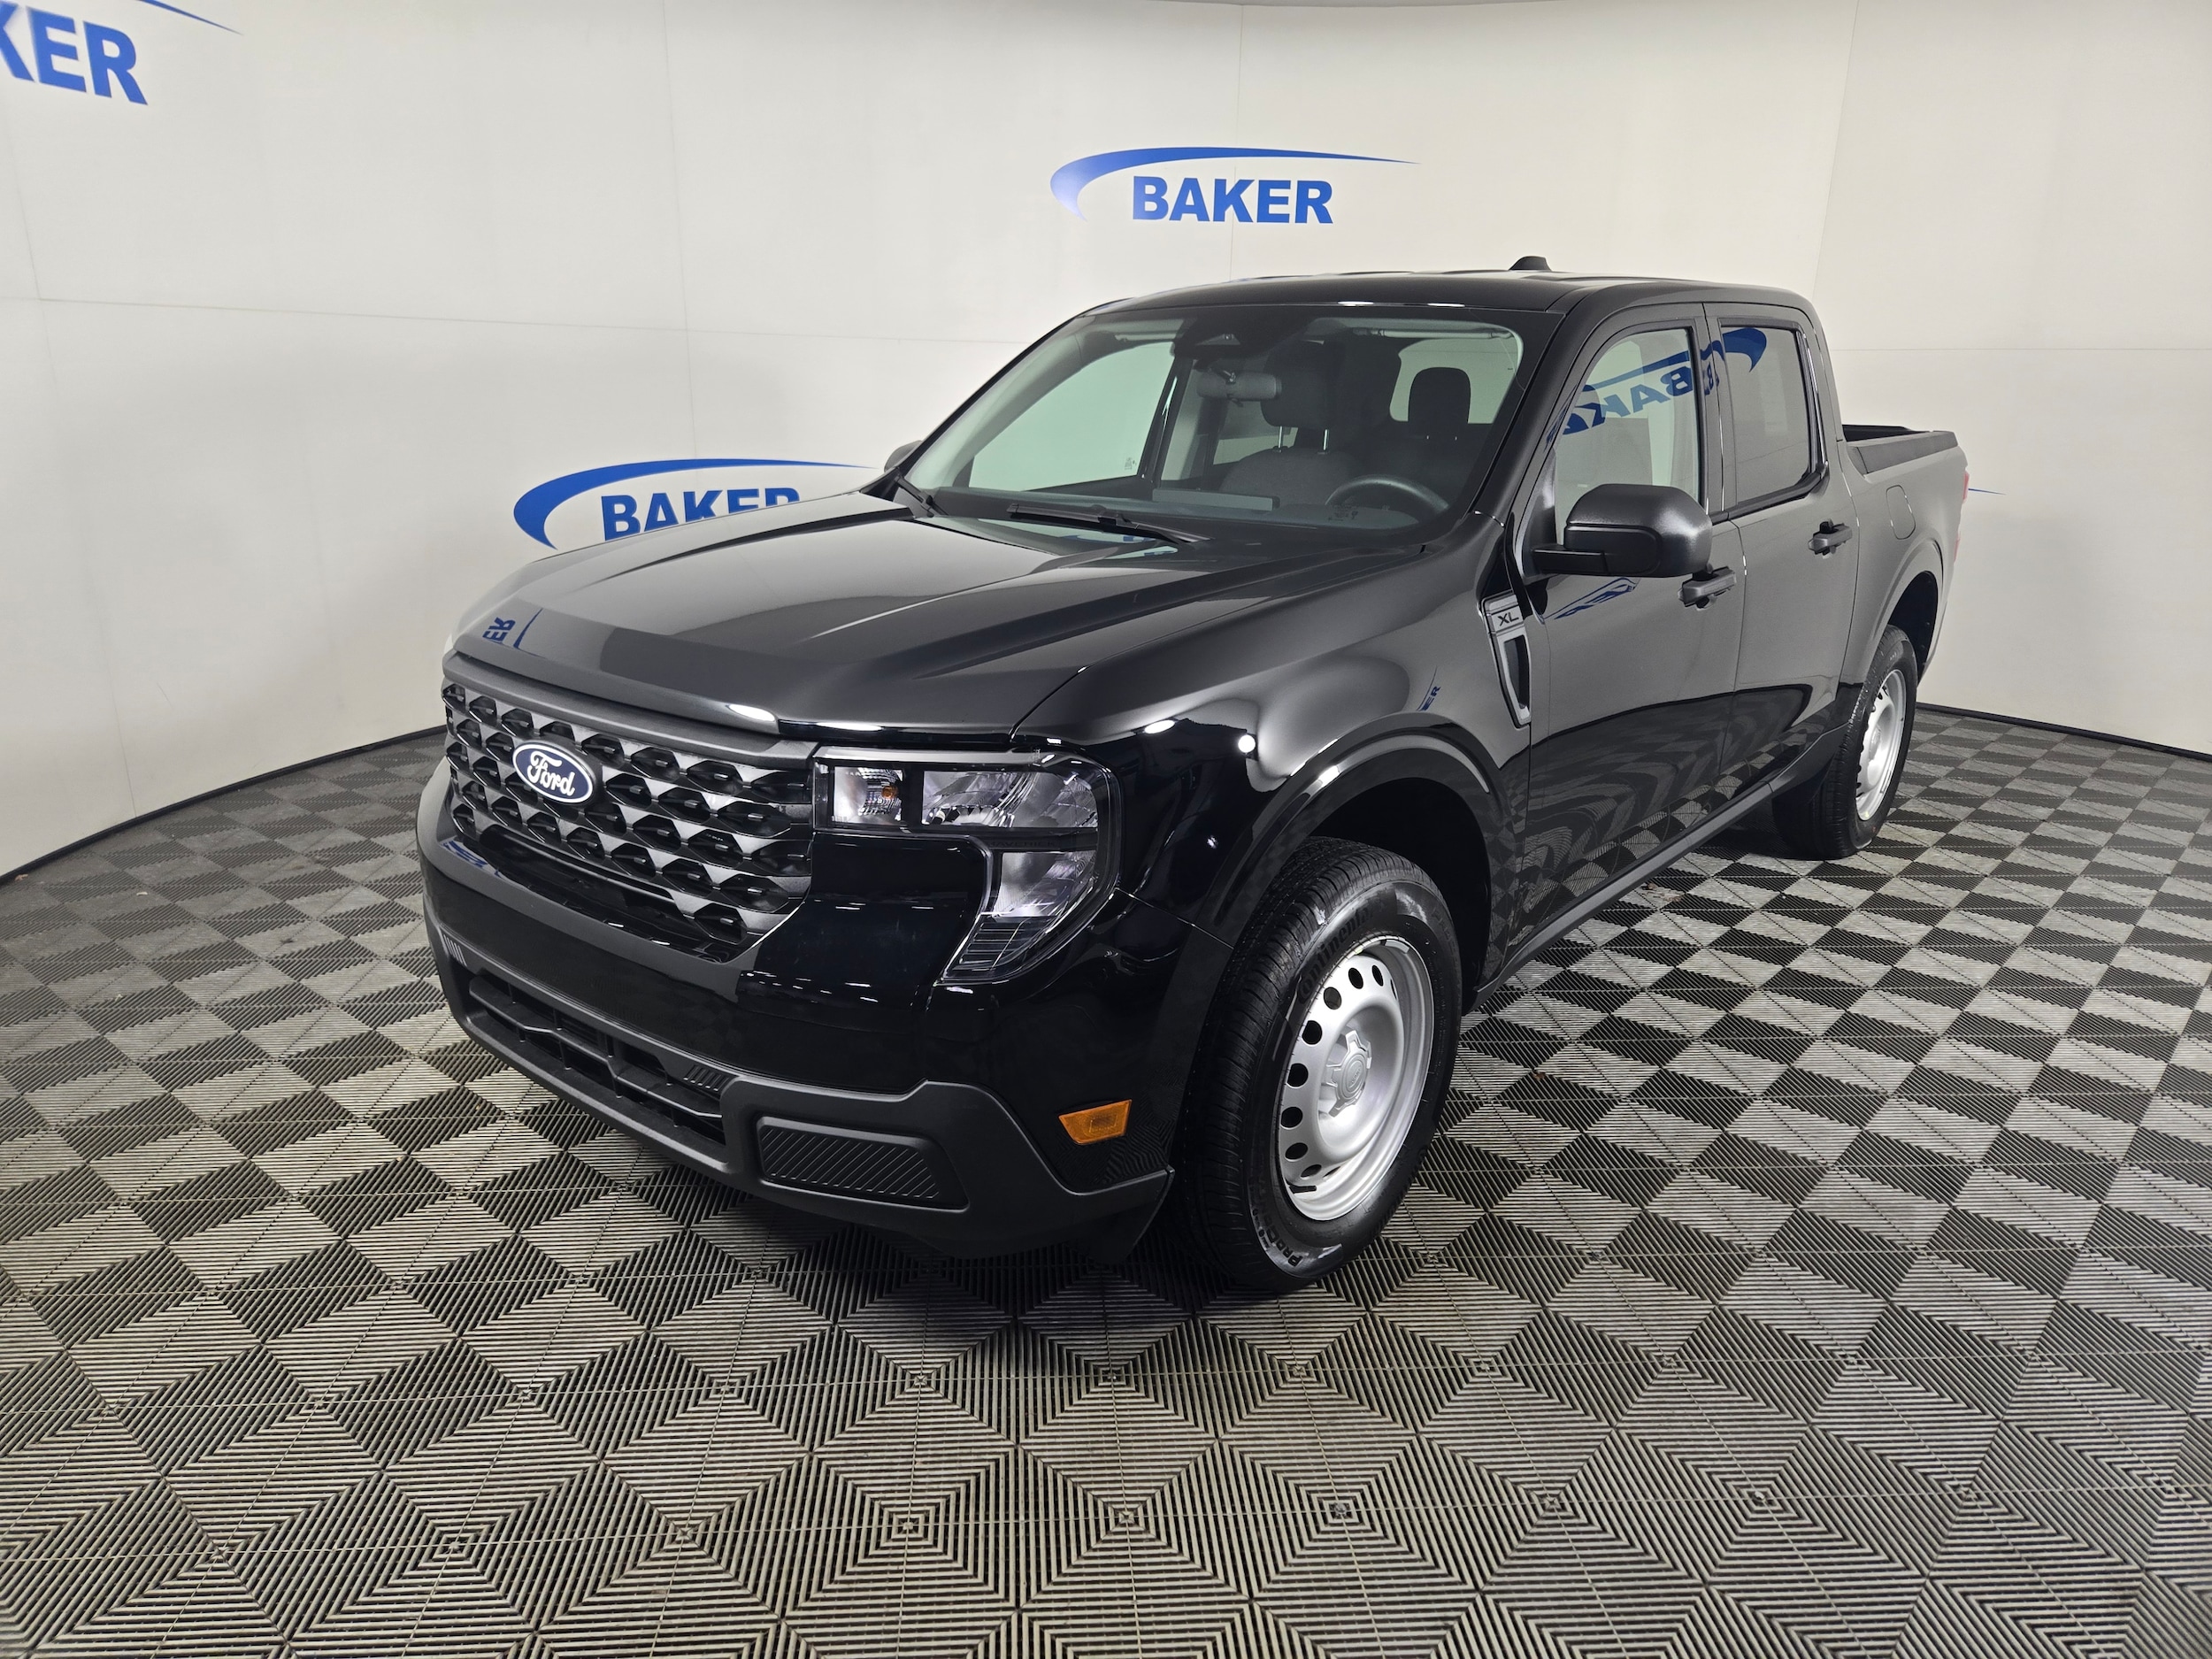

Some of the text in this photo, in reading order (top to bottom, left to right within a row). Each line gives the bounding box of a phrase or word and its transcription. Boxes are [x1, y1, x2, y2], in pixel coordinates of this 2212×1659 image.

[1133, 175, 1333, 224] BAKER
[1497, 611, 1519, 626] XL
[526, 750, 576, 796] Ford
